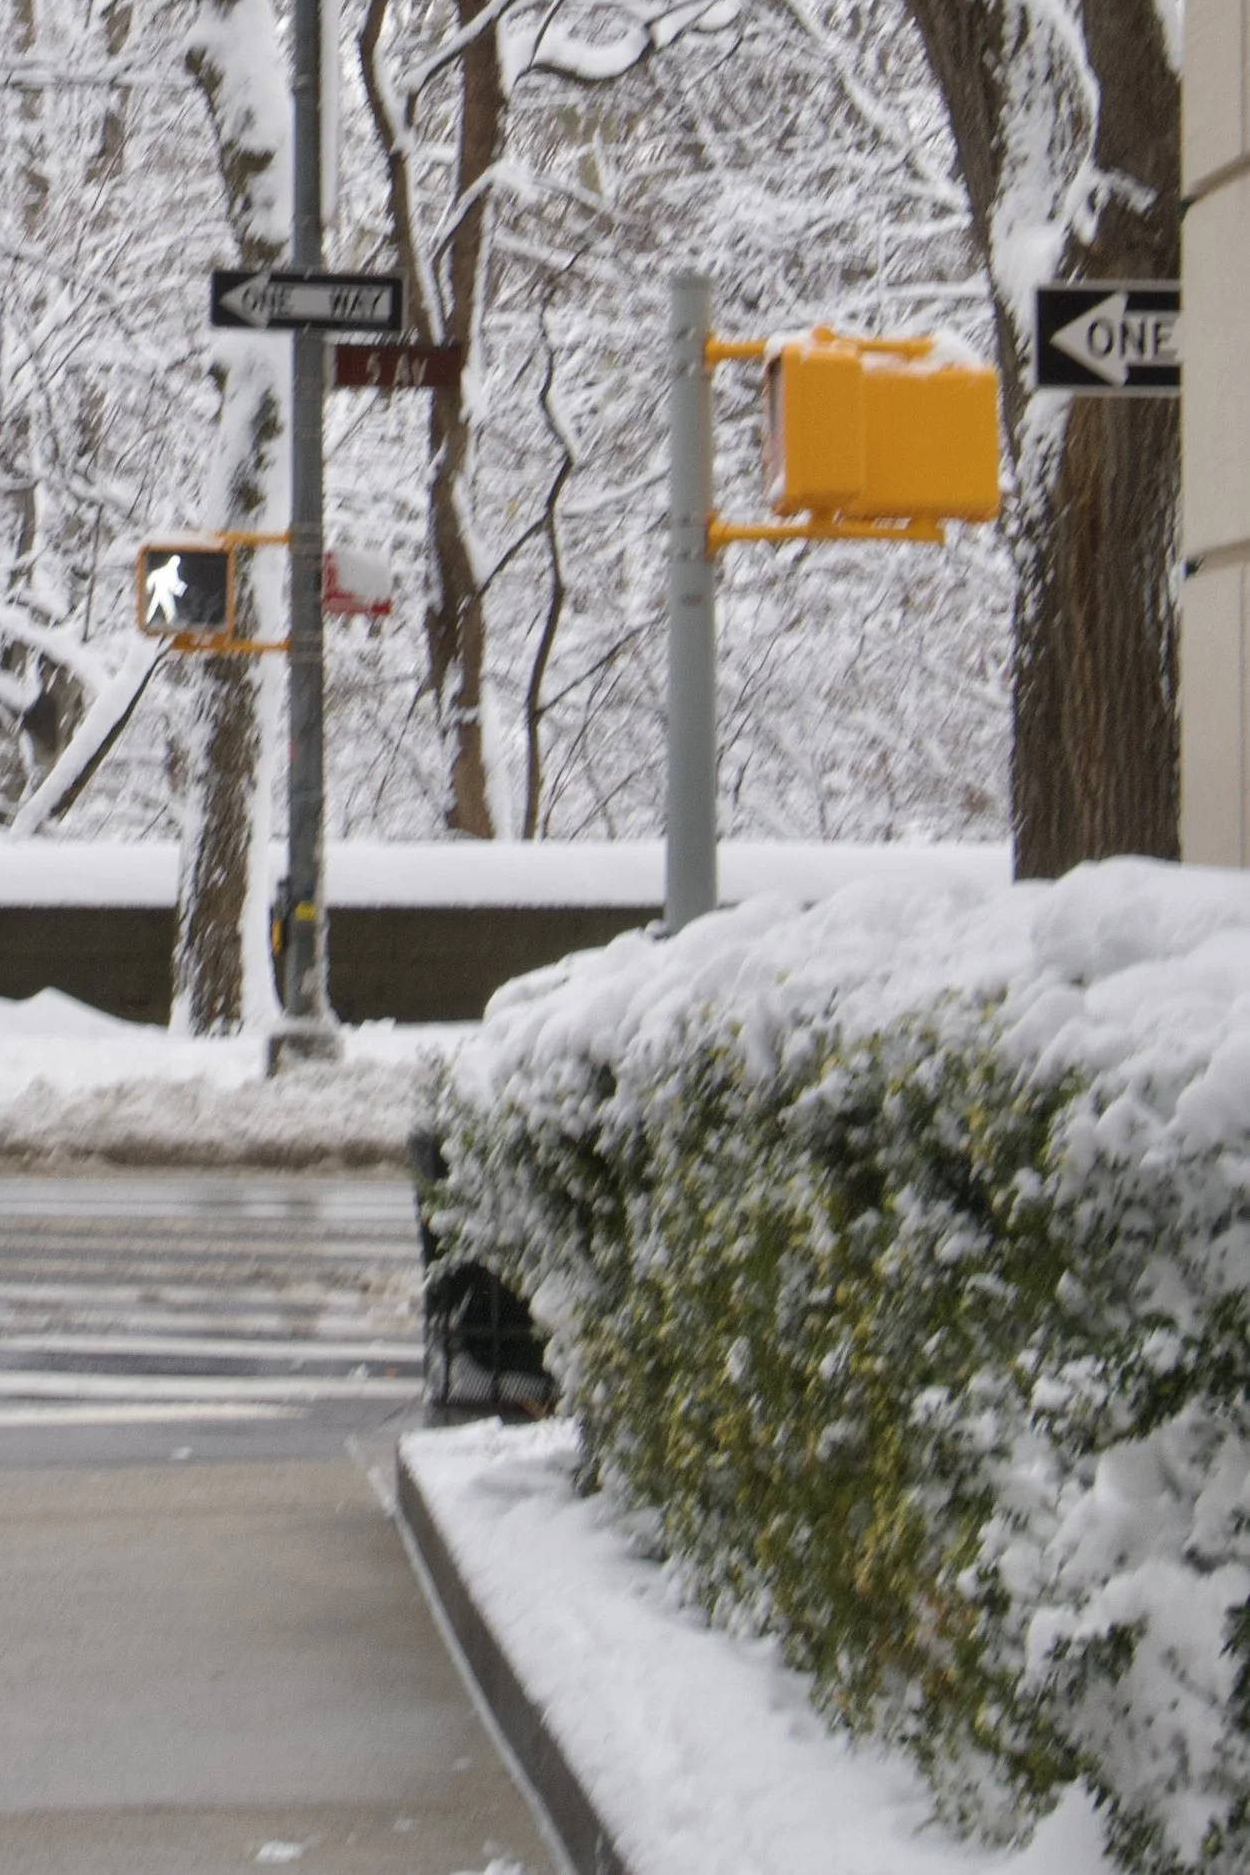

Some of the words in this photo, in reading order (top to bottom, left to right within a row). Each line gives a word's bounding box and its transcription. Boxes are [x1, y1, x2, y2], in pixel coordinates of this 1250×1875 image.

[241, 285, 290, 321] ONE
[330, 286, 386, 321] WAY
[1087, 317, 1178, 360] ONE
